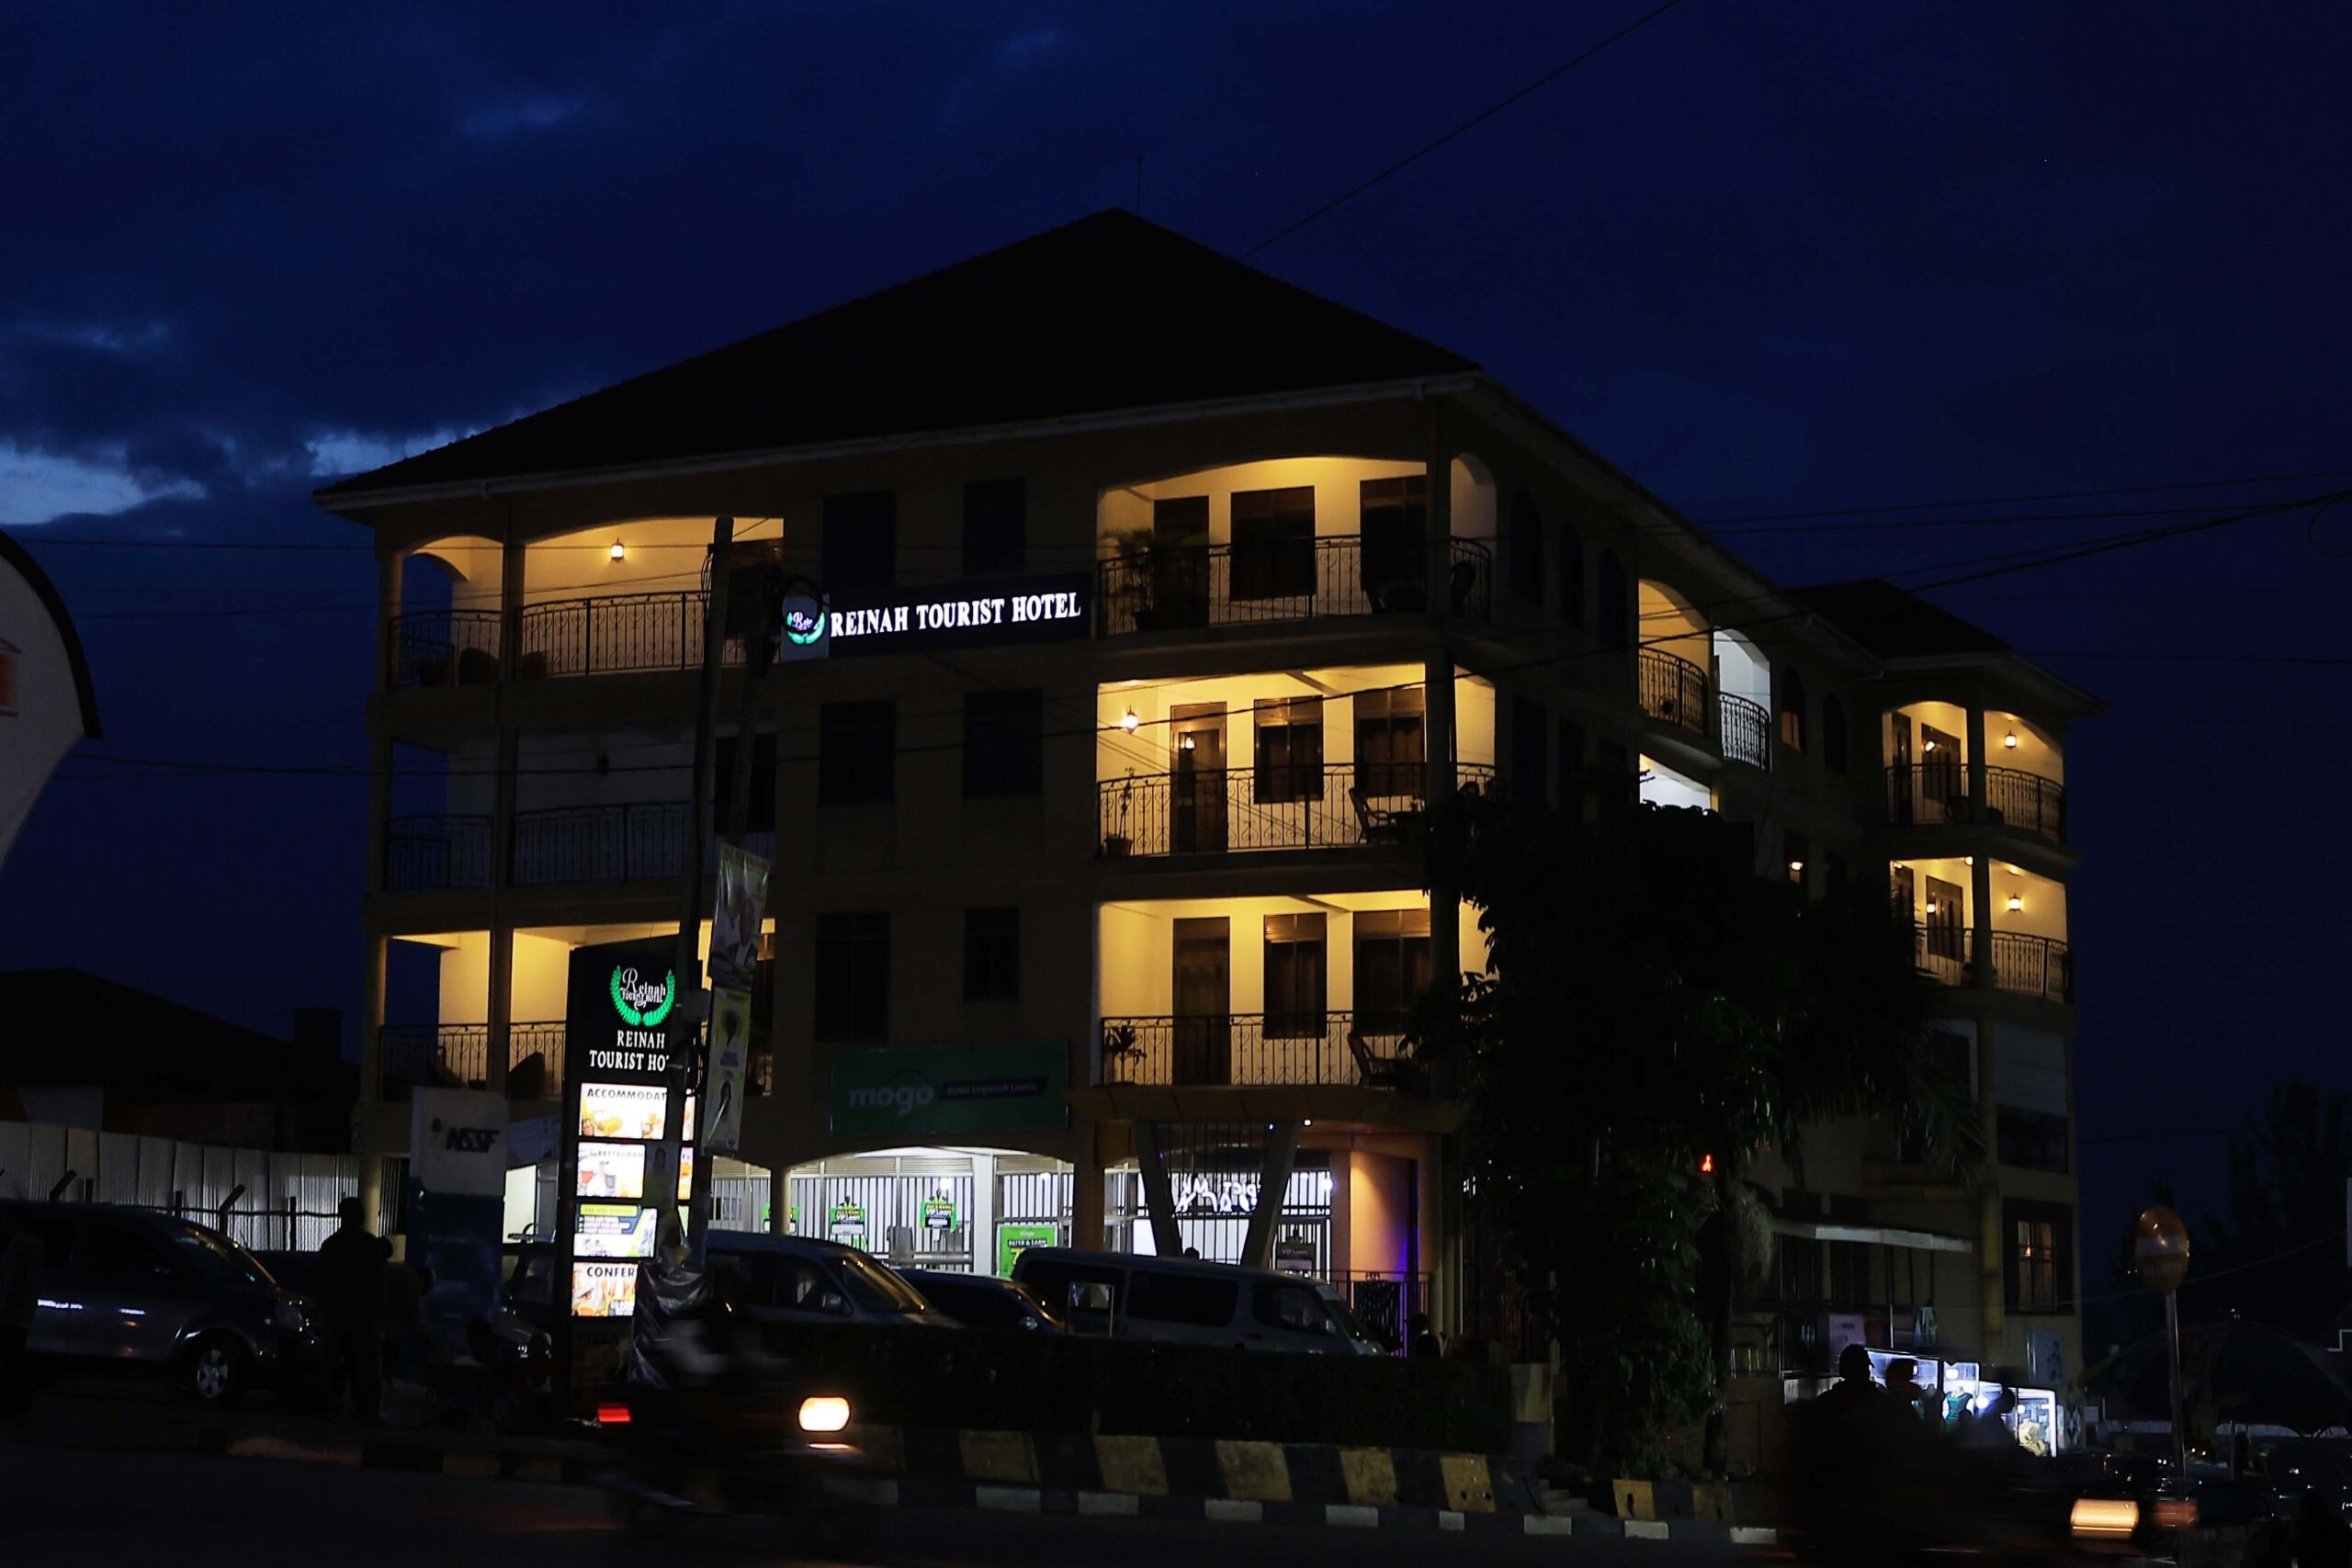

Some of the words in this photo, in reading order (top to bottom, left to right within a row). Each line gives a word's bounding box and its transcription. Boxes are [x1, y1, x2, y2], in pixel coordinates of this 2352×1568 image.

[830, 606, 909, 637] REINAH
[917, 598, 1005, 630] TOURIST
[1012, 592, 1081, 622] HOTEL
[616, 1030, 665, 1049] REINAH
[589, 1050, 644, 1071] TOURIST
[648, 1054, 670, 1072] HO
[848, 1084, 934, 1116] mogo
[446, 1128, 500, 1152] NSSF
[587, 1266, 635, 1278] CONFER
